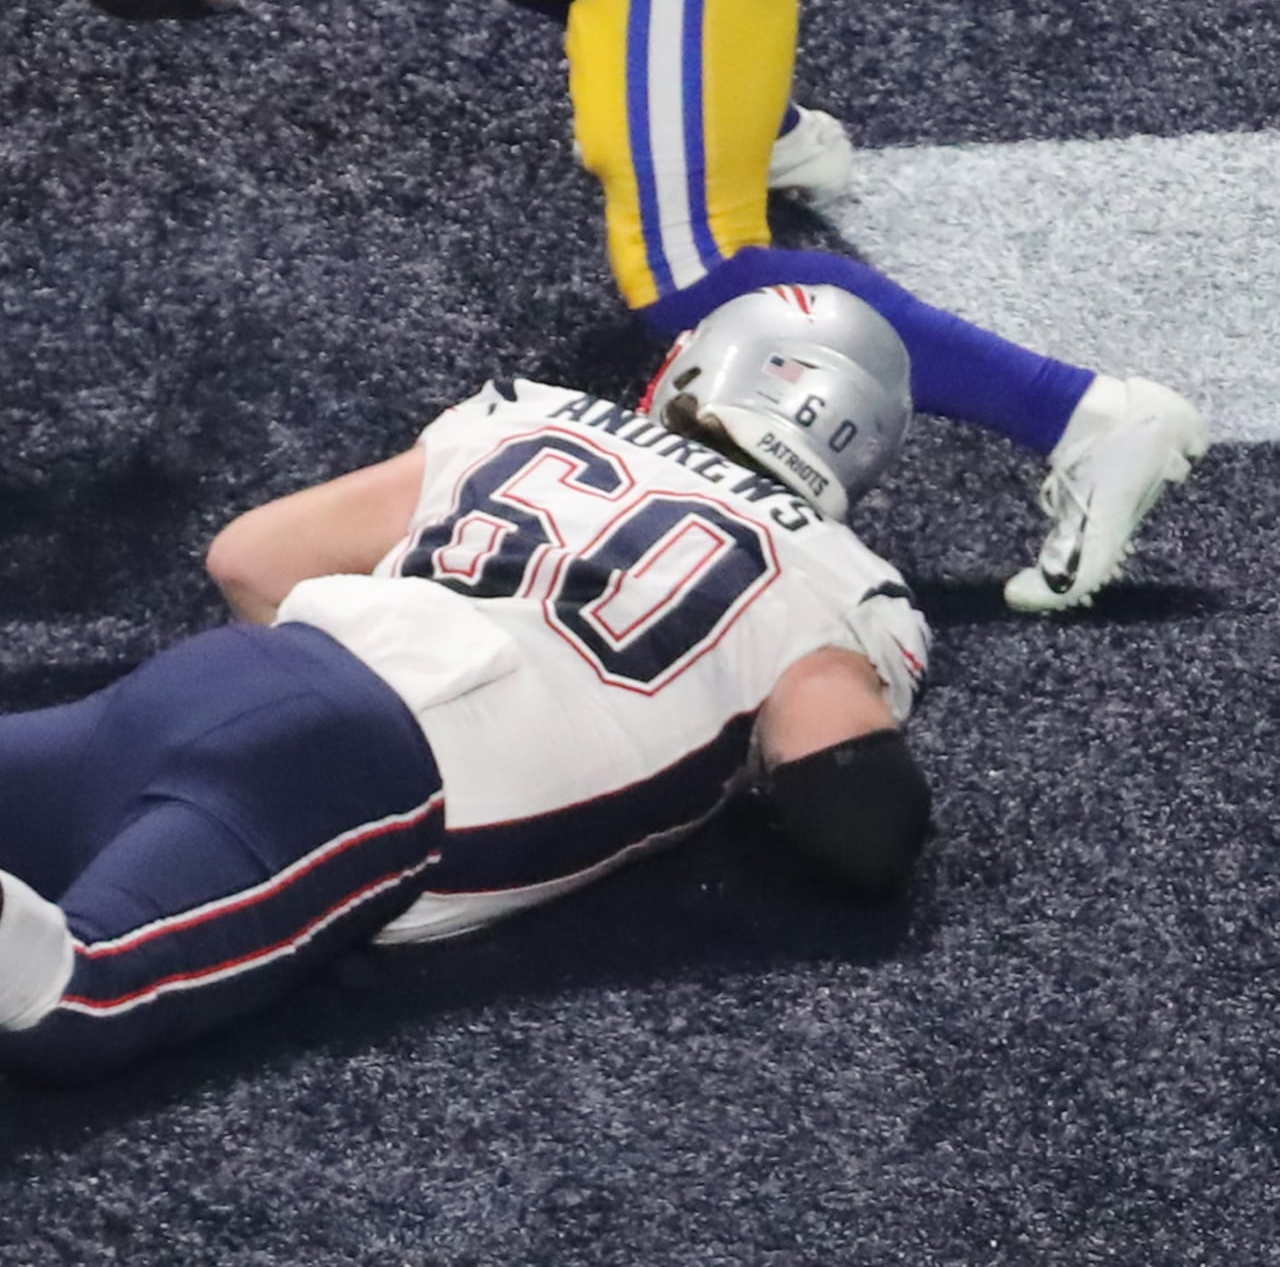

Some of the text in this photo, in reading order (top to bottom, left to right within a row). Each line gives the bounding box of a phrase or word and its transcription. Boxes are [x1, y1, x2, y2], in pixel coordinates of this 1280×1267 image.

[794, 393, 858, 453] 60
[756, 431, 830, 498] PATRIOTS
[386, 424, 782, 697] 60
